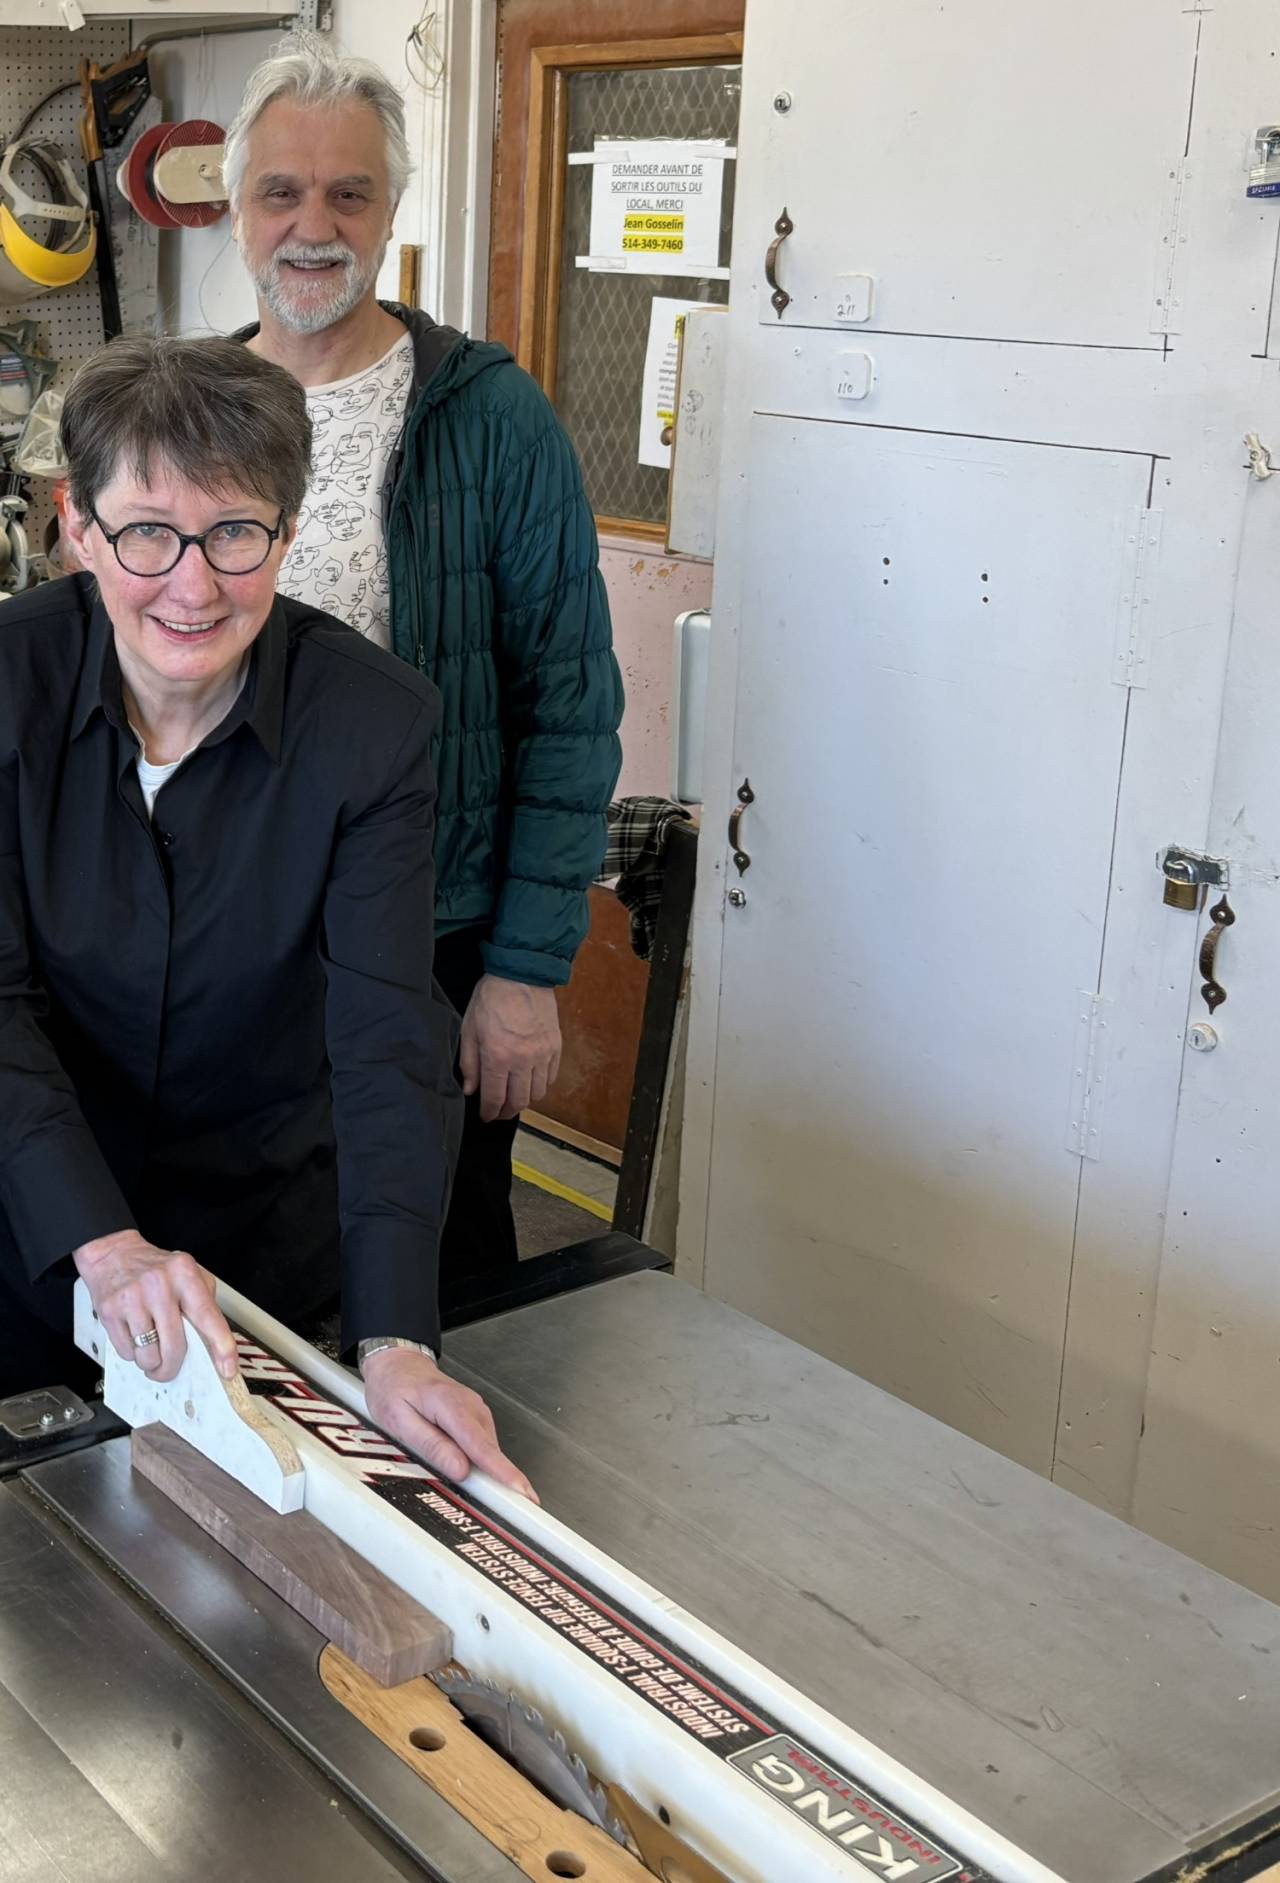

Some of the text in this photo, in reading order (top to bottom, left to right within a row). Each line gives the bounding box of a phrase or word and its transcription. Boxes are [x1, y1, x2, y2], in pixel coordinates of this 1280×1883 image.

[612, 164, 703, 175] DEMANDER AVANT DE
[611, 181, 702, 193] SORTIR LES OUTILS DU
[656, 200, 684, 209] MERCI
[624, 218, 684, 230] Jean Gosselin
[622, 238, 683, 250] 514-349-7460
[414, 1490, 480, 1531] T-SQUARE
[454, 1540, 724, 1738] INDUSTRIAL T-SQUARE RIP FENCE SYSTEM
[607, 1634, 664, 1668] GUIDE
[653, 1666, 684, 1685] DE
[753, 1751, 919, 1880] KING
